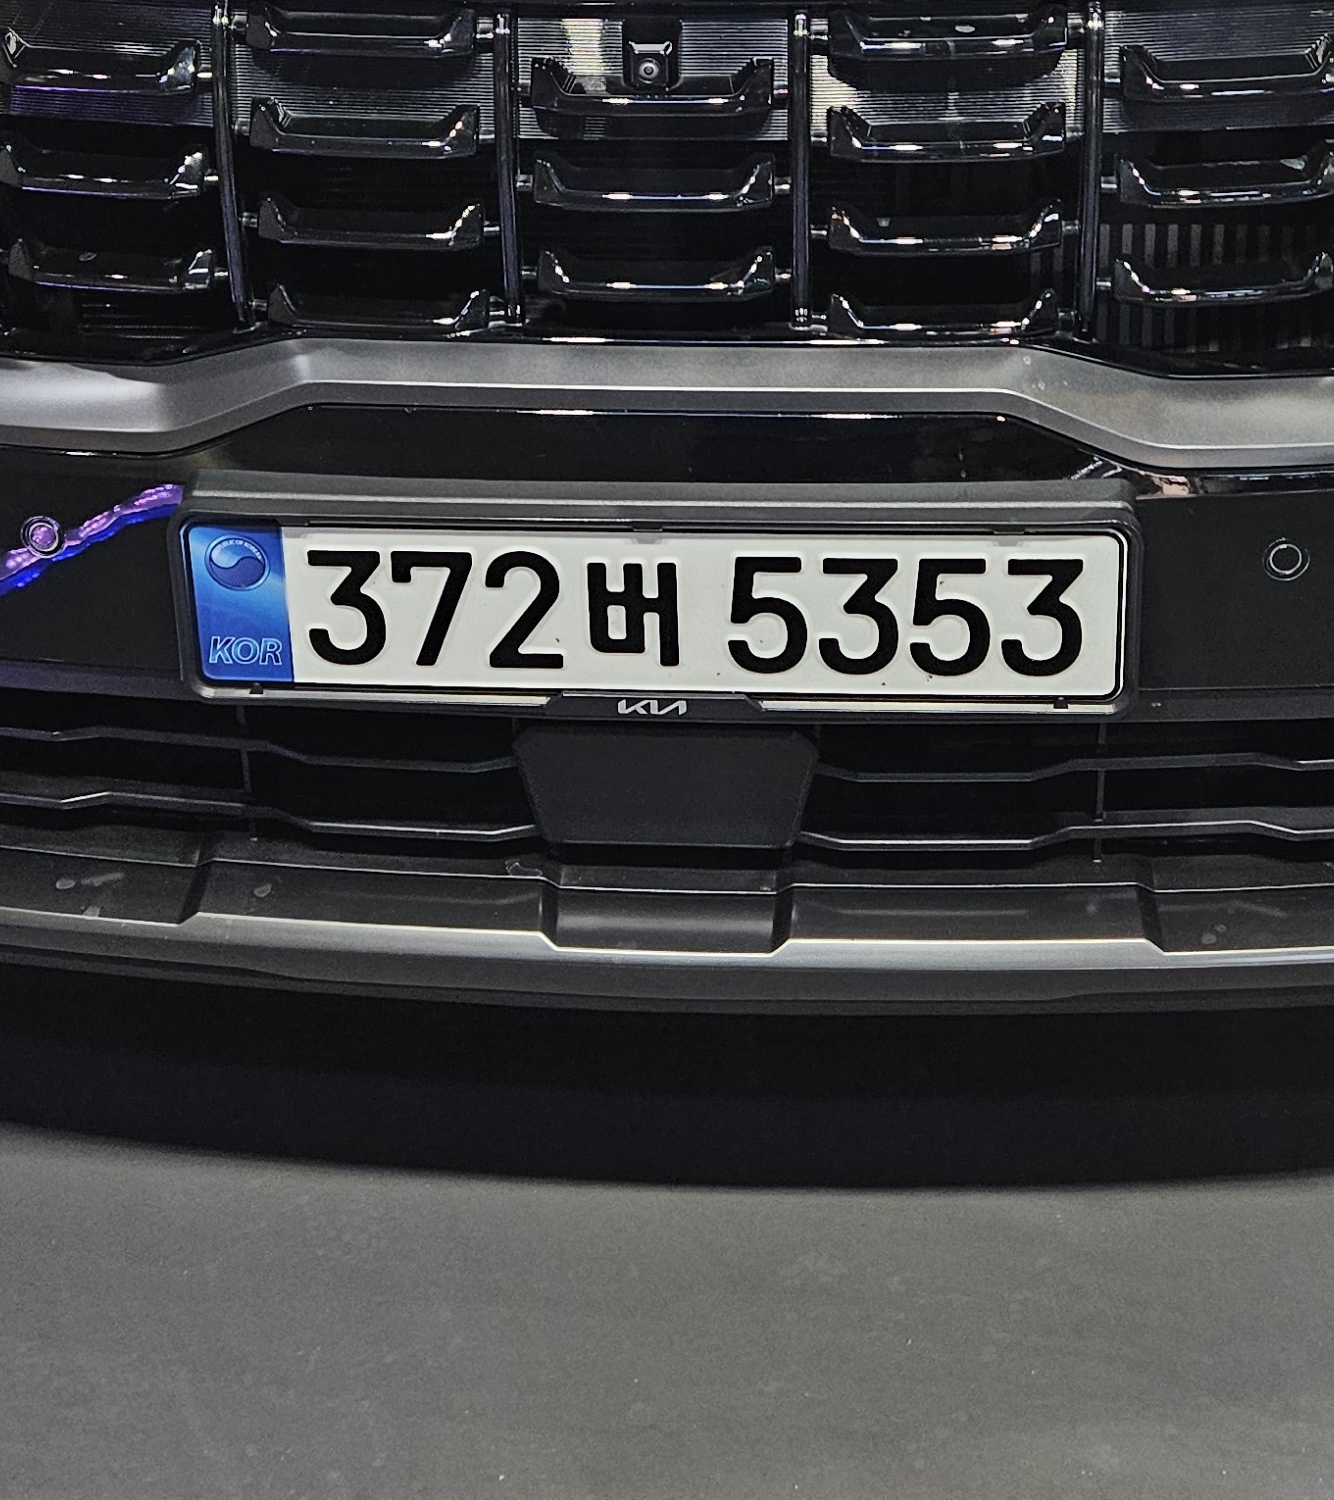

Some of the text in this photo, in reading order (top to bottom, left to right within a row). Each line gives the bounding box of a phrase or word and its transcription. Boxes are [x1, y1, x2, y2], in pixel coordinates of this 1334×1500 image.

[209, 636, 282, 665] KOR
[307, 550, 1084, 677] 372버 5353
